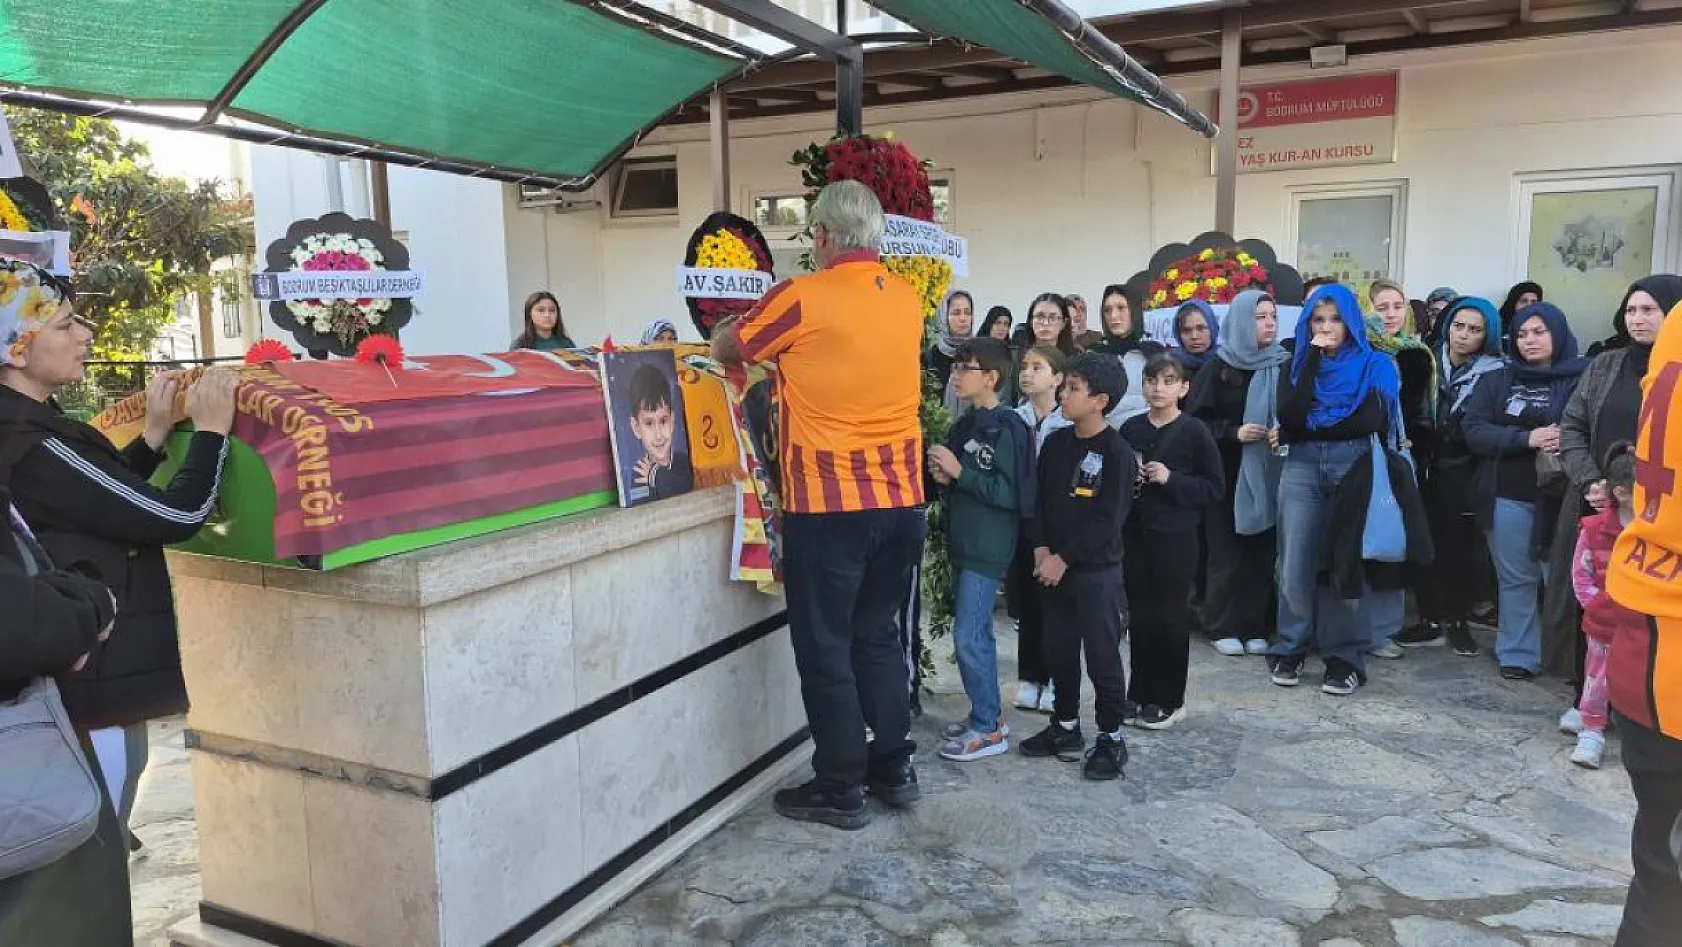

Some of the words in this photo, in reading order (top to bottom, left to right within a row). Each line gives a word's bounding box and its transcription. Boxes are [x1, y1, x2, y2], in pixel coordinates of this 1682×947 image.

[1266, 103, 1313, 117] BODRUM
[1315, 94, 1384, 113] MÜFTÜLÜĞÜ
[1238, 137, 1254, 149] EZ
[1268, 148, 1321, 163] KUR-AN
[1324, 145, 1374, 160] KURSU
[282, 279, 316, 294] BODRUM
